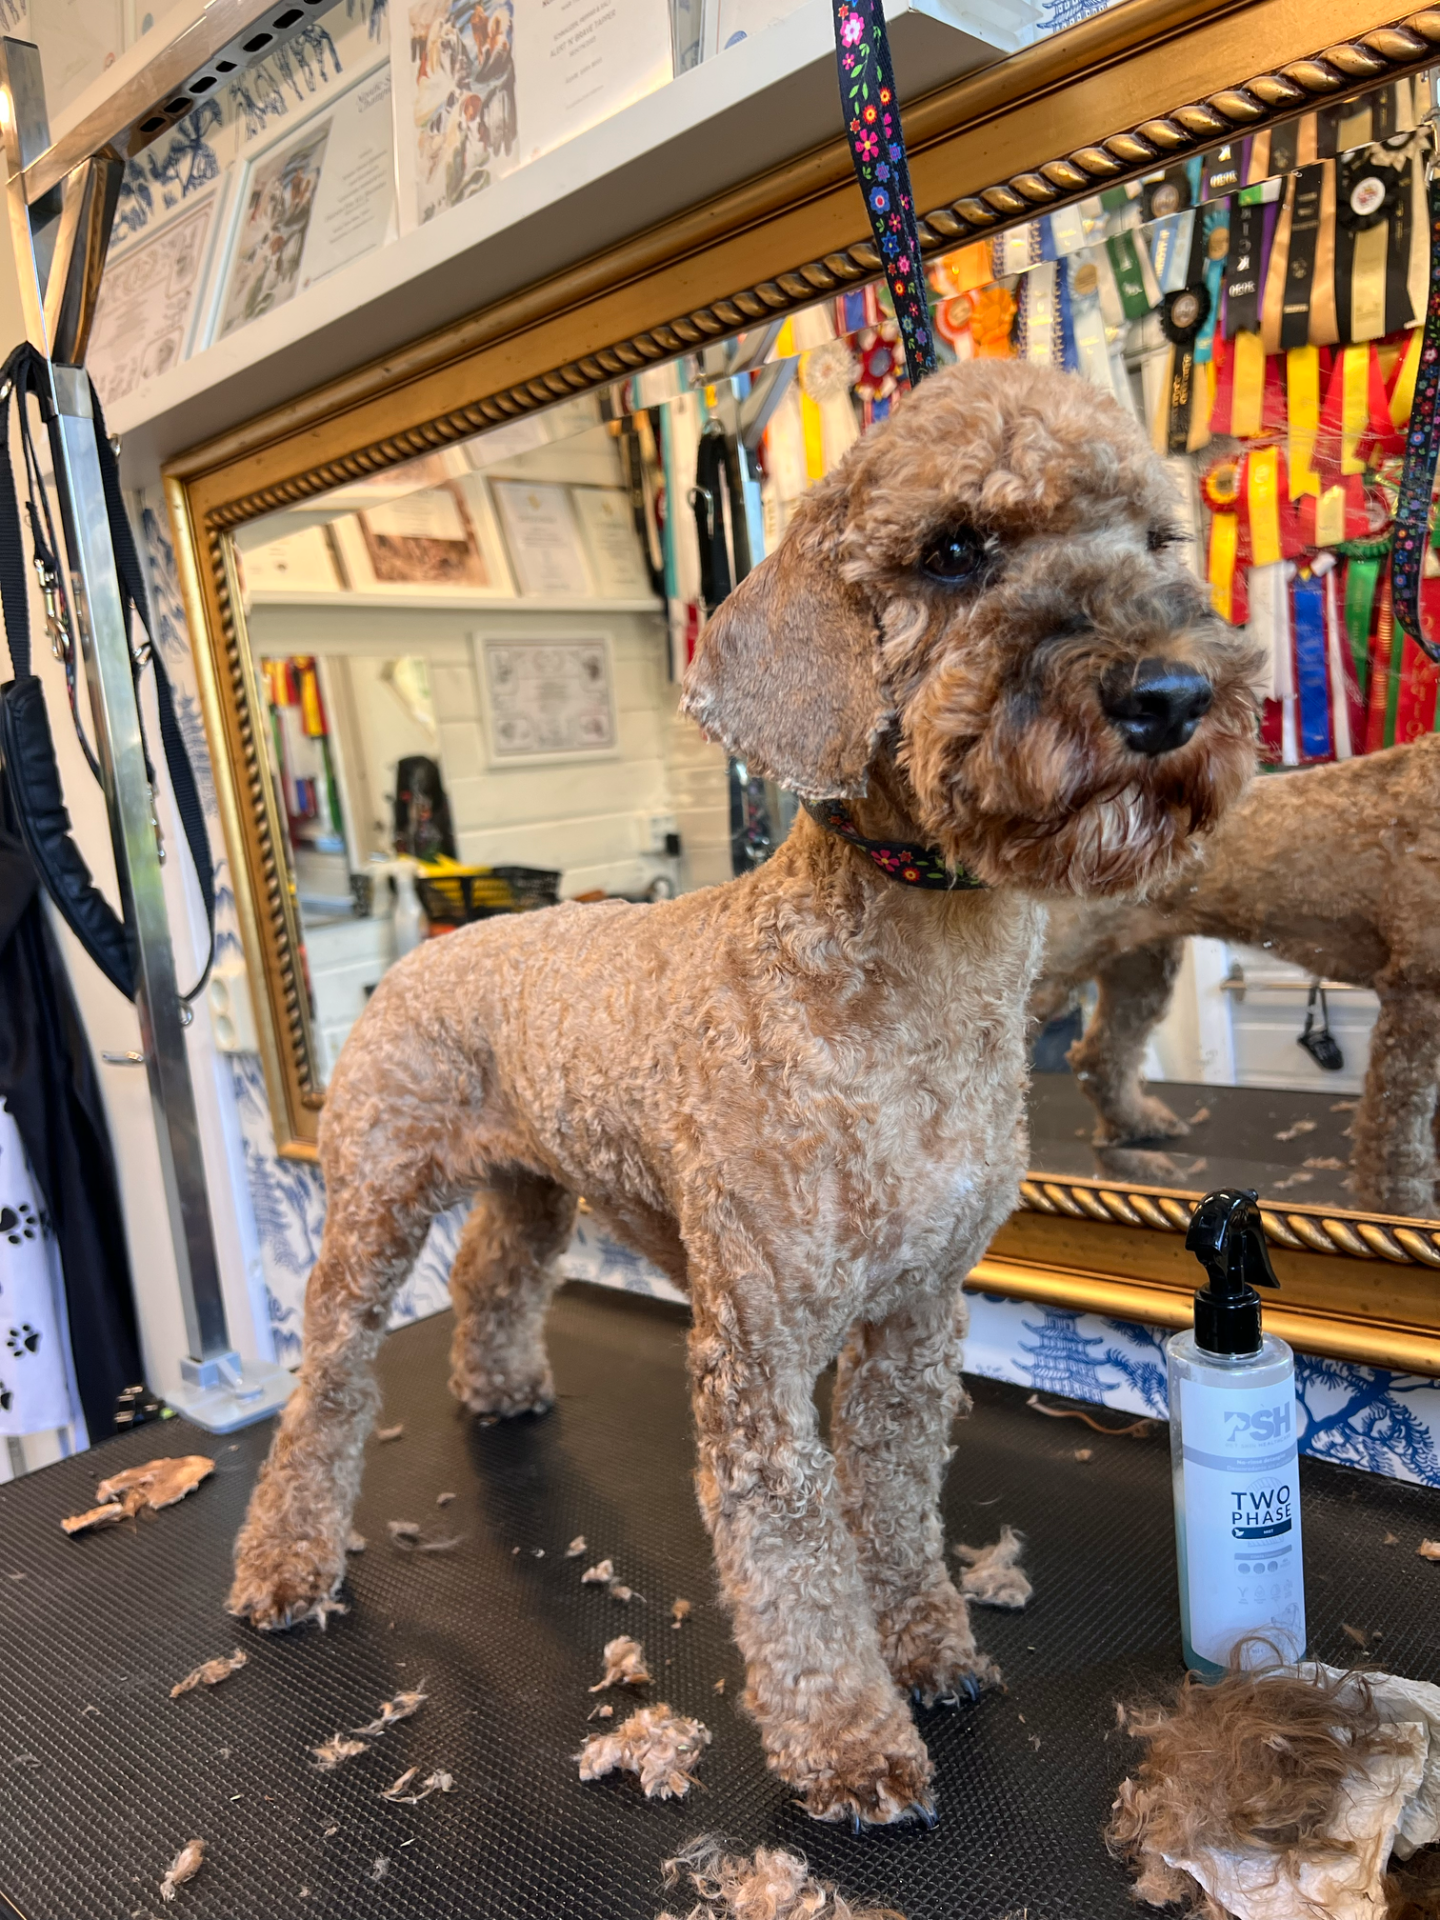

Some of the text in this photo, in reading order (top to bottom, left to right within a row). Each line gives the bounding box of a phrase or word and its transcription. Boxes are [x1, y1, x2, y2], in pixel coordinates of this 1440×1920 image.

[1224, 1401, 1291, 1442] PSH
[1231, 1485, 1290, 1511] TWO
[1231, 1503, 1292, 1526] PHASE
